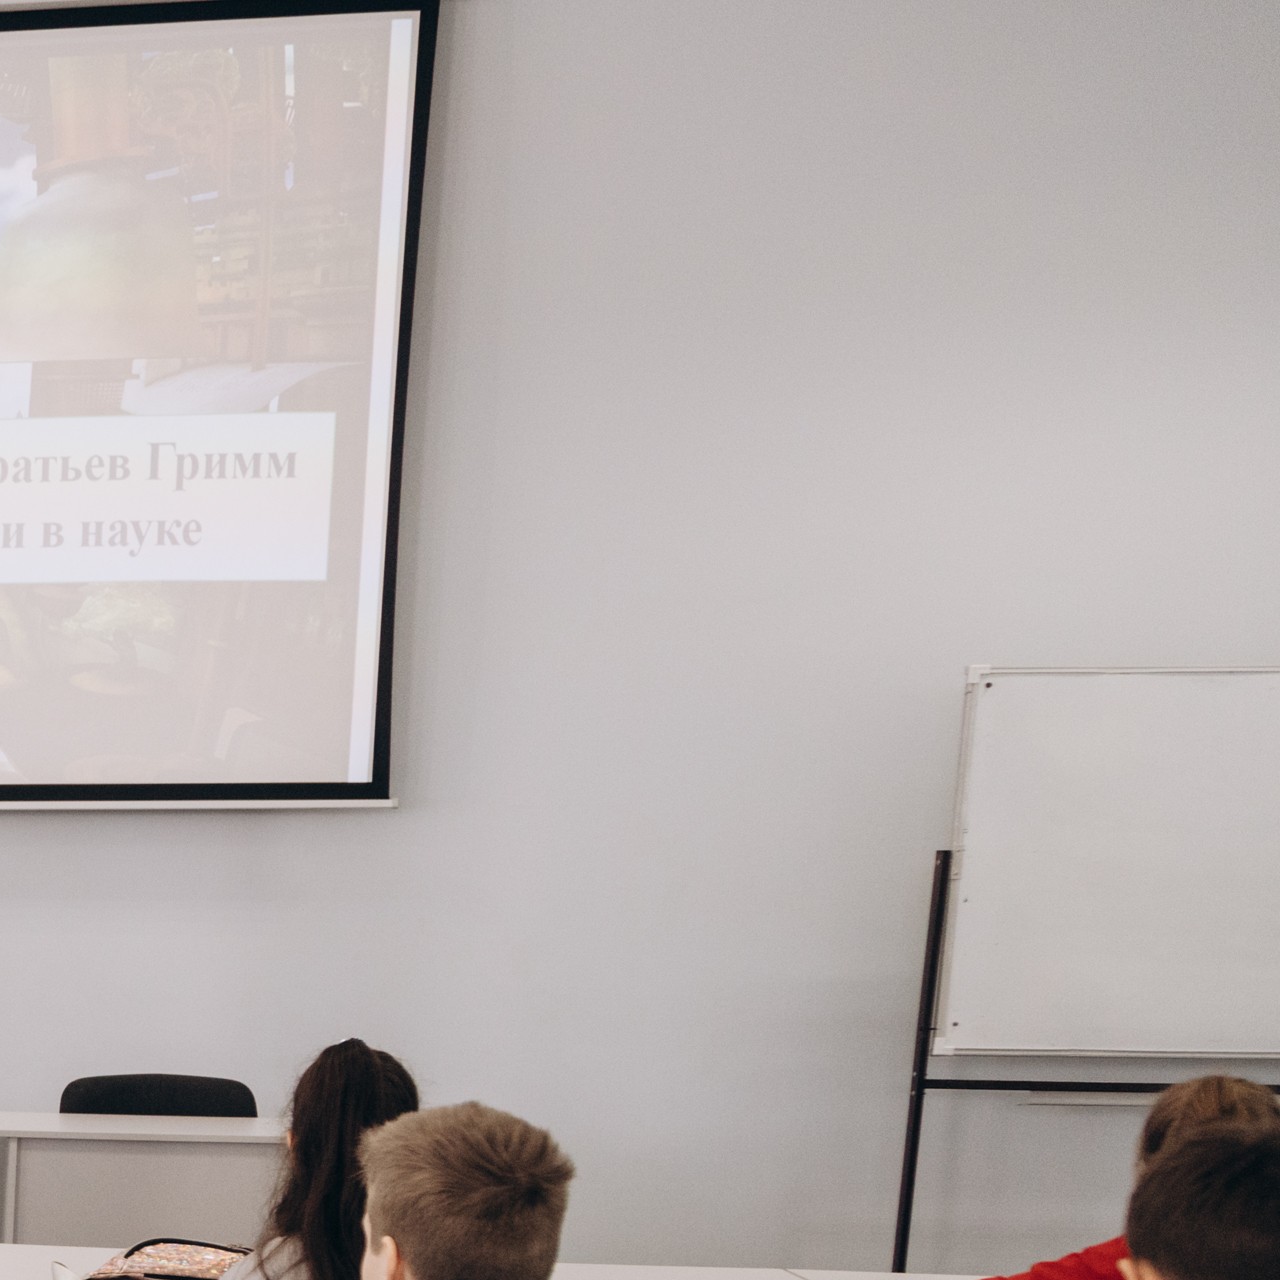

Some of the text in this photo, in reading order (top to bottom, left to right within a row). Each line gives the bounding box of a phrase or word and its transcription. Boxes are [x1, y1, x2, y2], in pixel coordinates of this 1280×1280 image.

[145, 441, 298, 491] Гримм
[1, 521, 26, 549] и
[41, 521, 65, 548] в
[80, 517, 203, 557] науке
